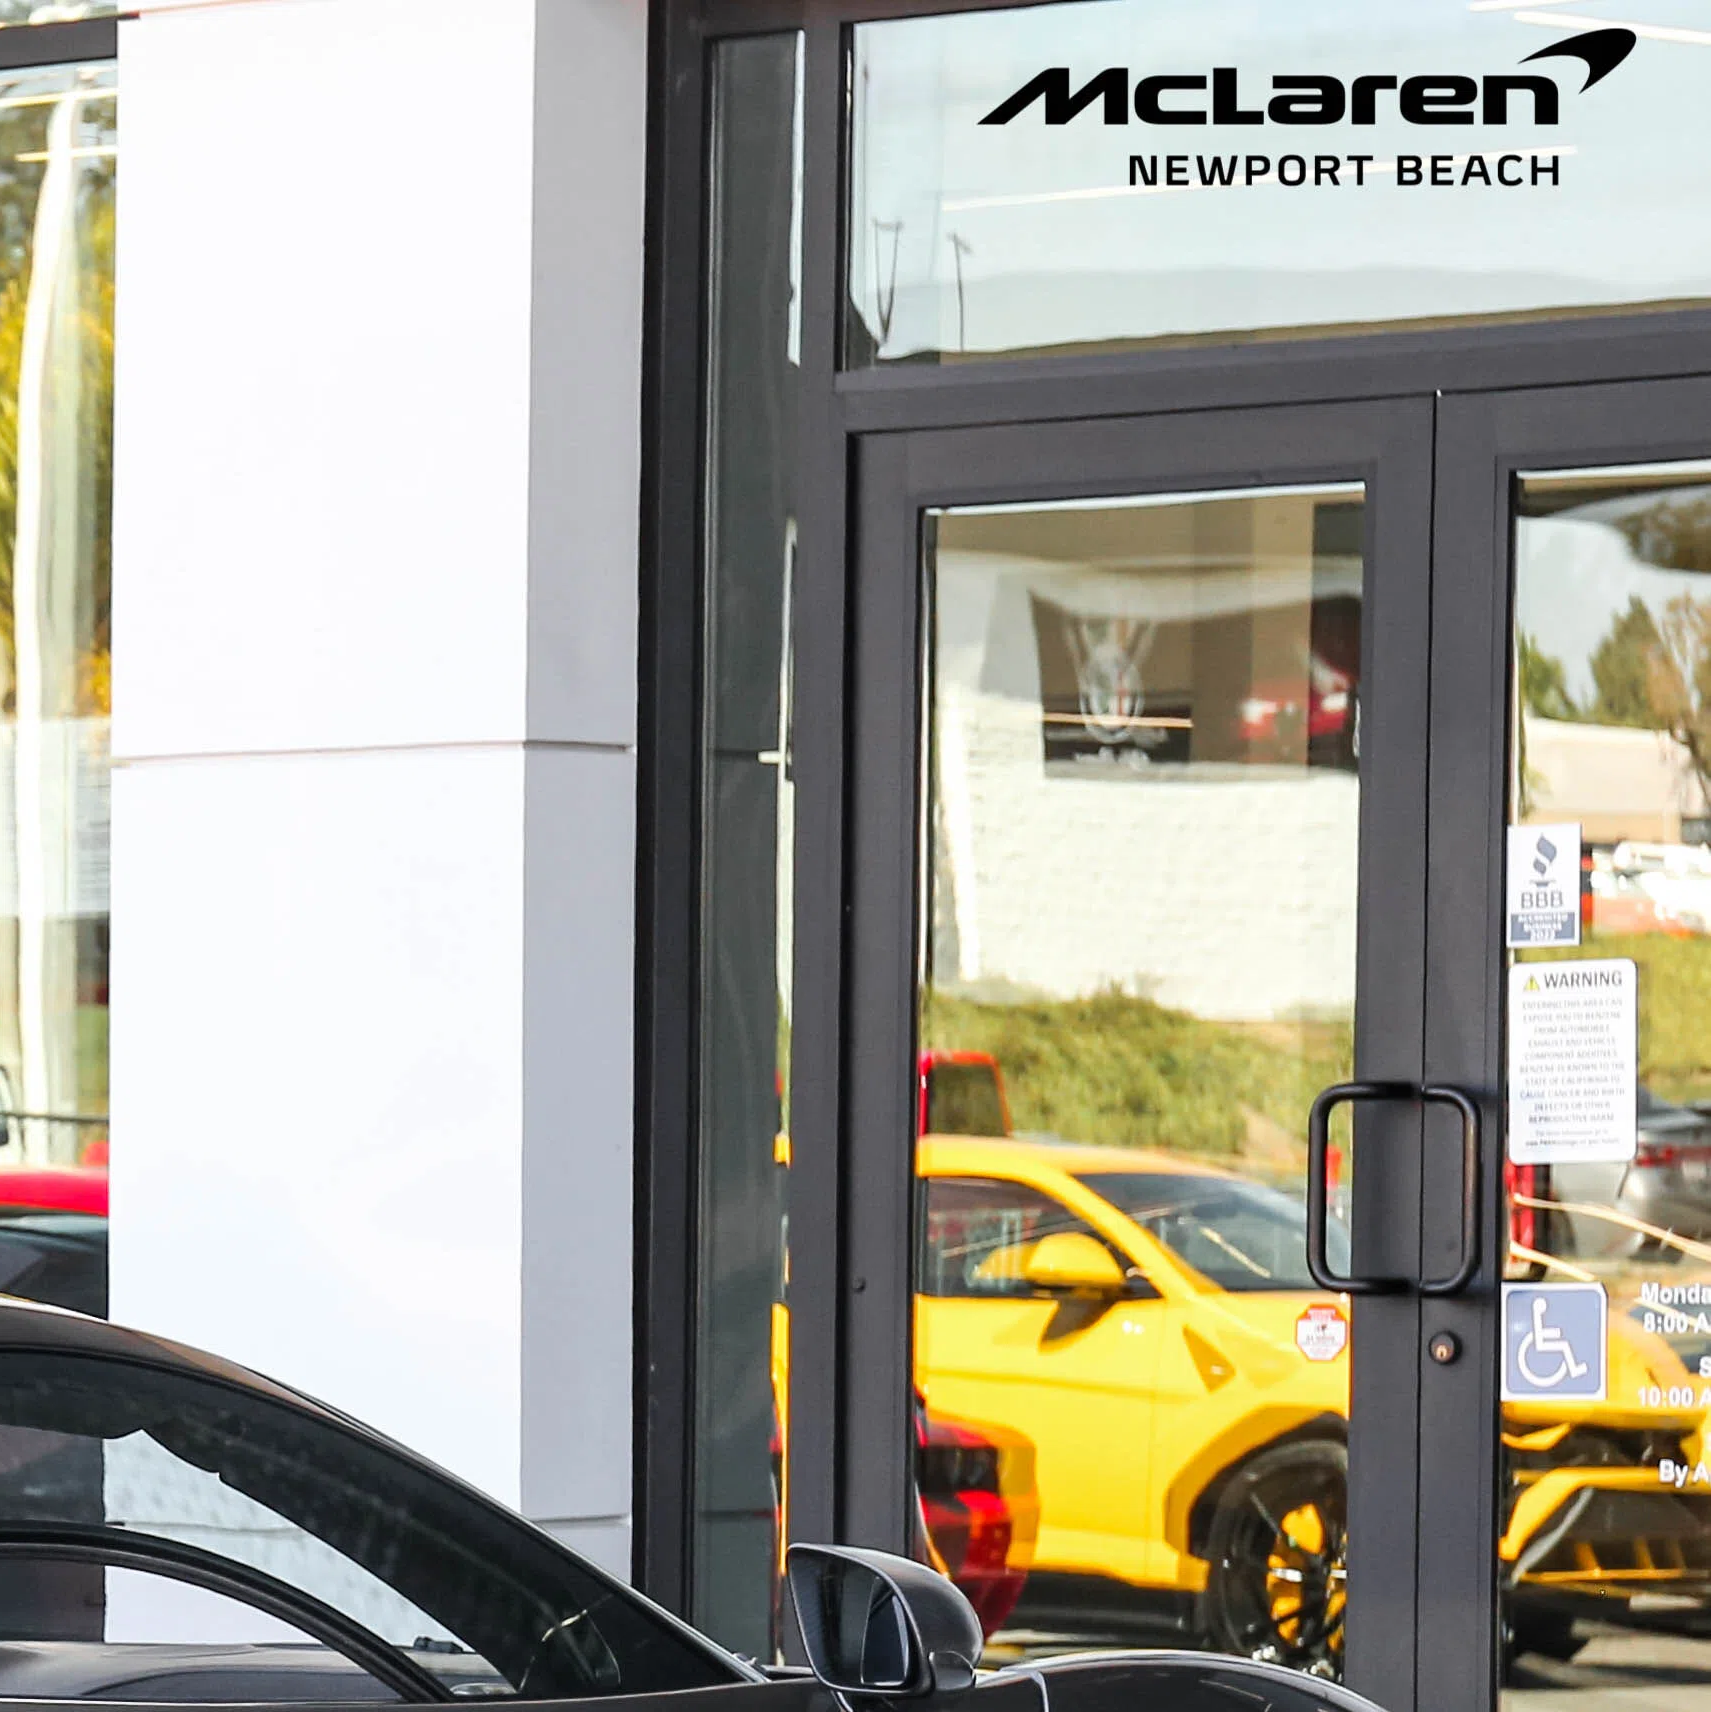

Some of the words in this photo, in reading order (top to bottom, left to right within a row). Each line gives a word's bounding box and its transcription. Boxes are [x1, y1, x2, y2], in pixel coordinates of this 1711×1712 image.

[1521, 889, 1563, 909] BBB
[1543, 970, 1623, 988] WARNING
[1644, 1312, 1689, 1333] 8:00
[1638, 1386, 1694, 1407] 10:00
[1658, 1459, 1689, 1488] By
